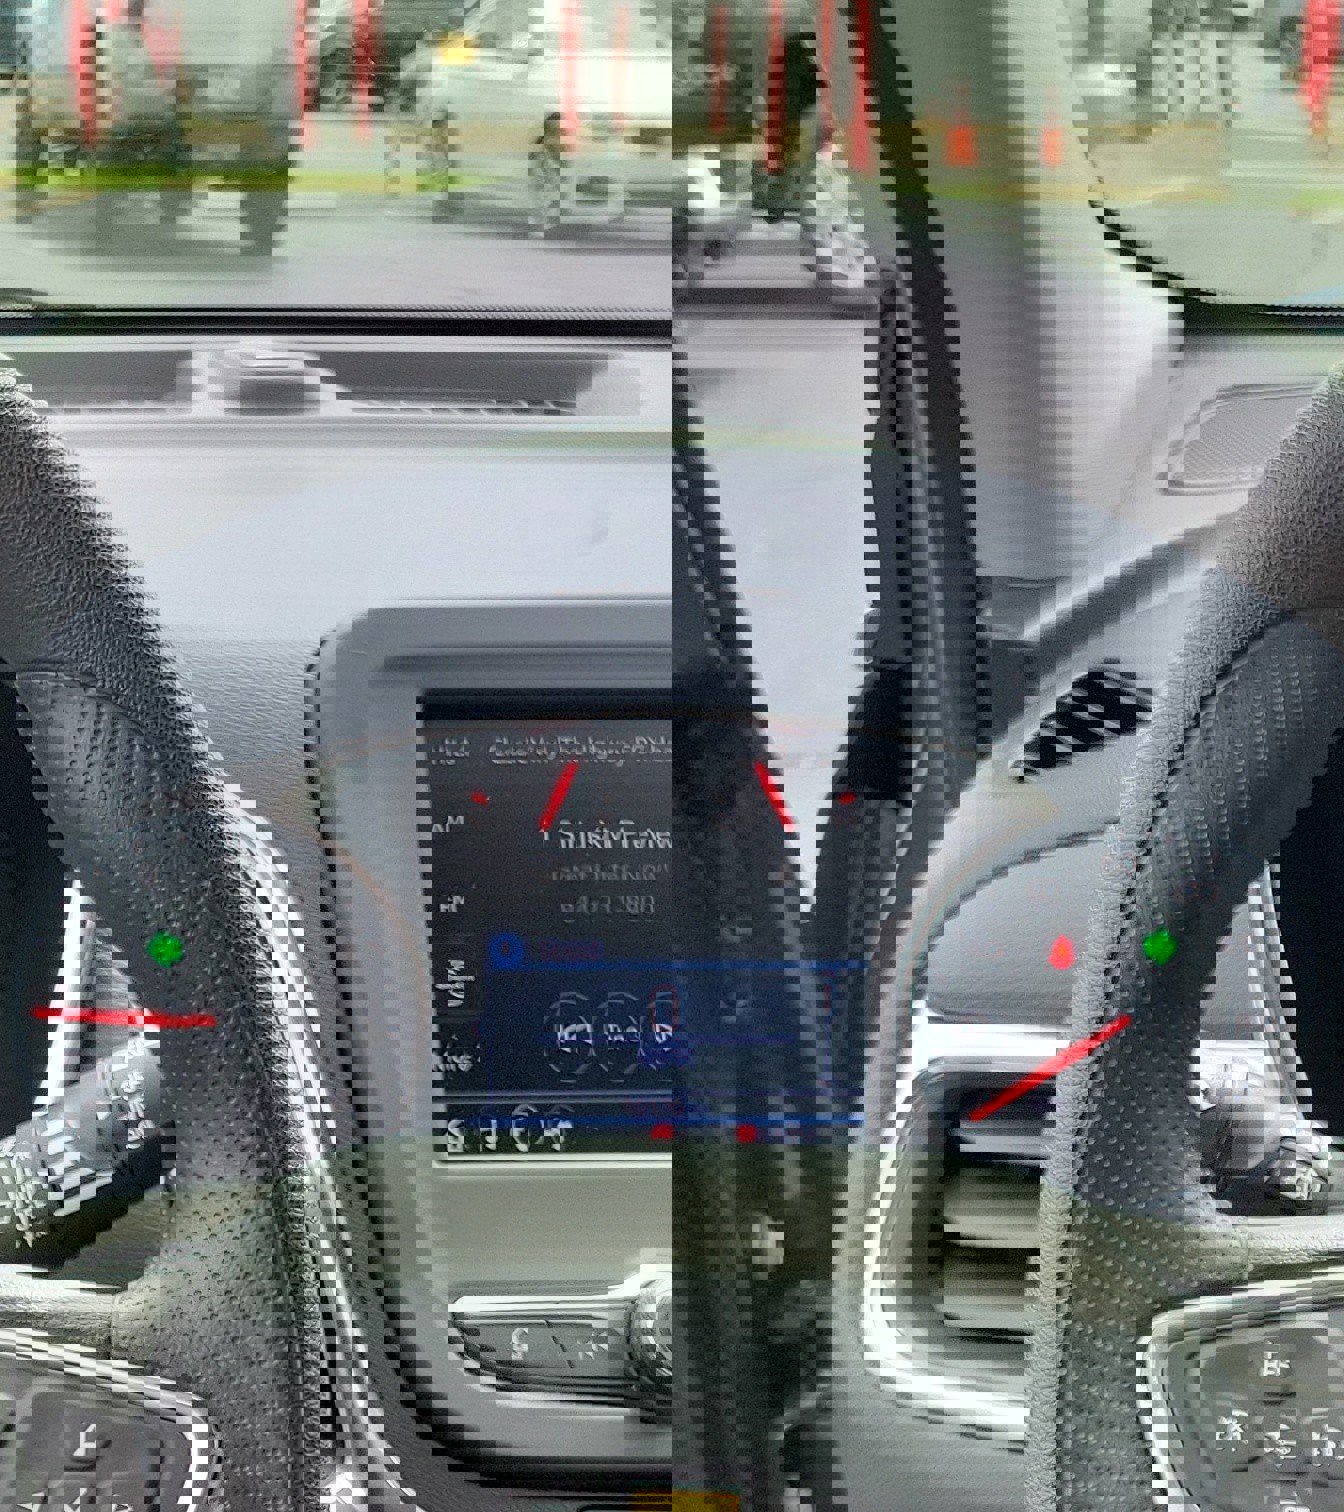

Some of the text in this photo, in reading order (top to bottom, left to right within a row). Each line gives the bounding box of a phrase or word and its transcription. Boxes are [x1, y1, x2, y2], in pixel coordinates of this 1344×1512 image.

[467, 806, 490, 834] E
[596, 806, 618, 834] F
[707, 806, 732, 834] C
[833, 805, 858, 834] H
[135, 859, 158, 889] 3
[211, 850, 236, 879] 4
[1099, 845, 1142, 877] 80
[285, 879, 309, 911] 5
[1021, 872, 1064, 904] 60
[1170, 874, 1221, 905] 100
[74, 904, 98, 935] 2
[334, 935, 360, 966] 6
[537, 936, 604, 966] Speed
[964, 933, 1006, 964] 40
[1216, 928, 1266, 959] 120
[646, 980, 684, 1036] 0
[949, 1007, 991, 1039] 20
[1231, 1005, 1281, 1037] 140
[355, 1013, 377, 1045] 7
[635, 1046, 696, 1073] MPH
[327, 1085, 351, 1116] 8
[1201, 1080, 1251, 1111] 160
